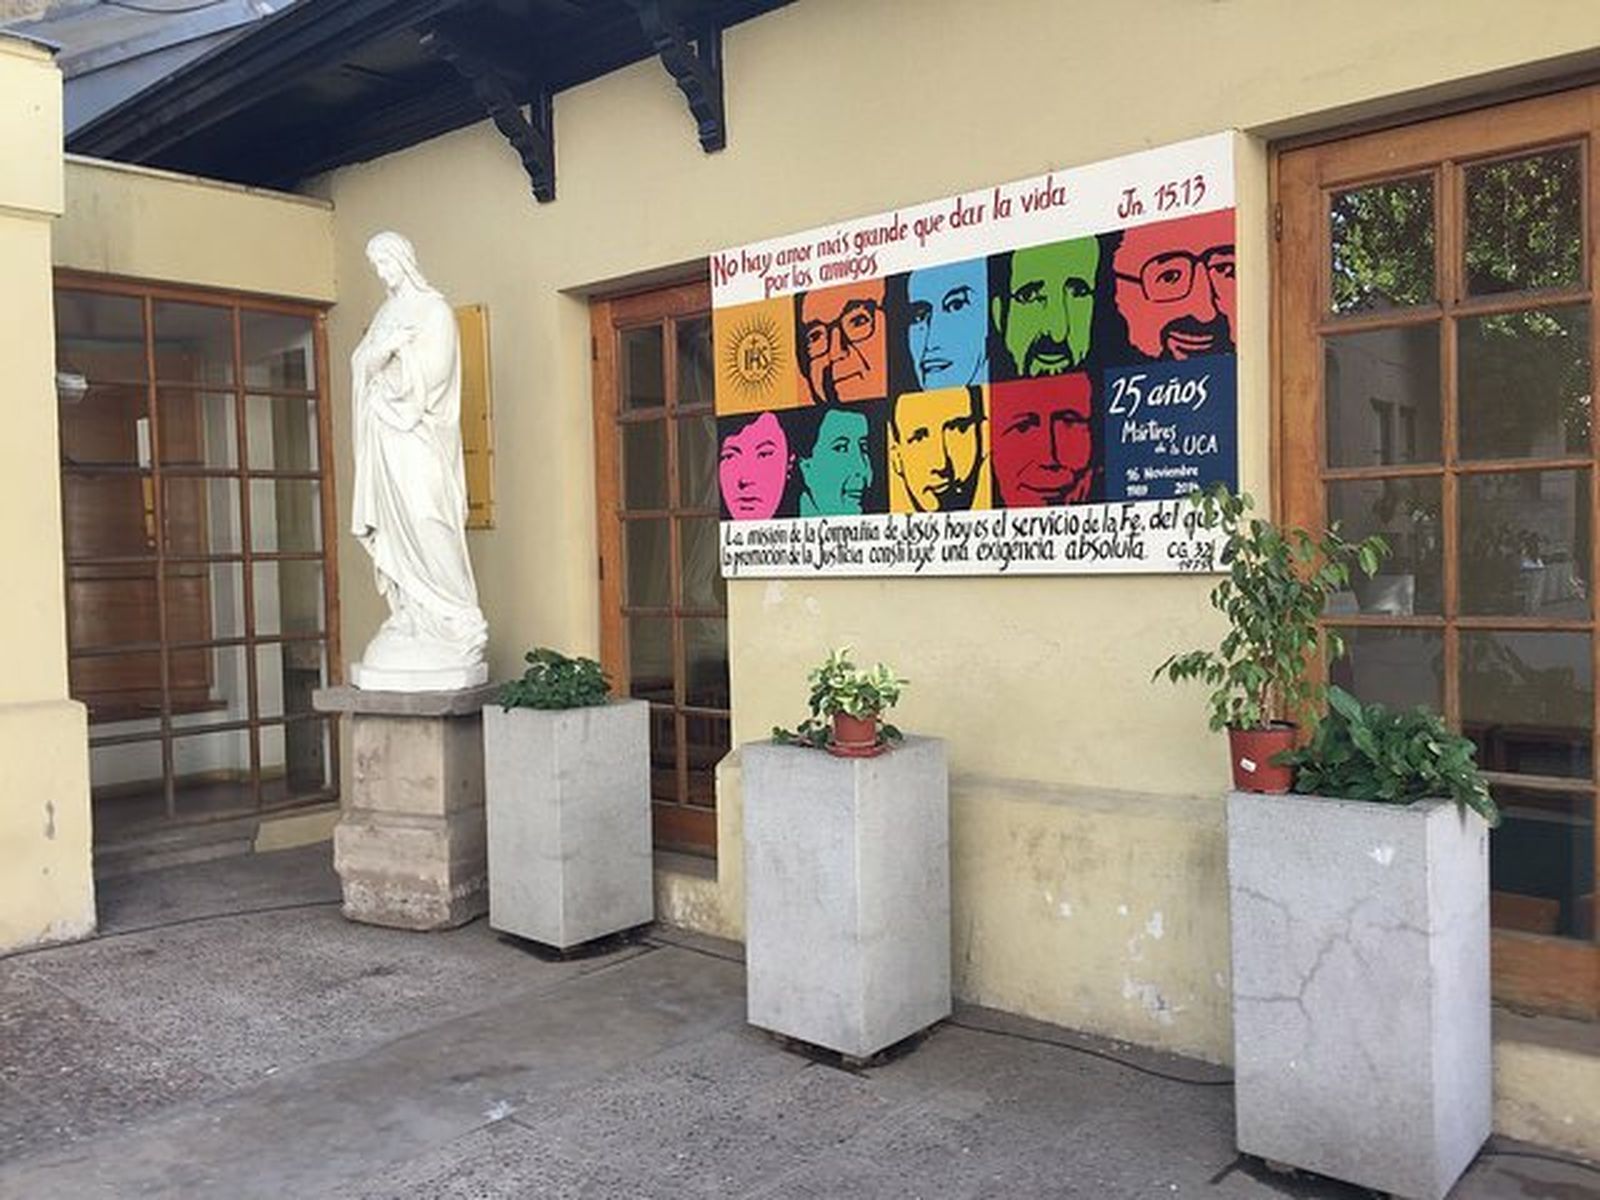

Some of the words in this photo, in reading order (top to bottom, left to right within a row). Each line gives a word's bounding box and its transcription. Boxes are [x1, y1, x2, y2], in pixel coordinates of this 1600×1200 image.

[714, 253, 738, 287] No
[741, 250, 773, 278] hay
[776, 244, 813, 266] amor
[853, 213, 908, 255] grande
[913, 214, 945, 247] que
[949, 197, 985, 228] dar
[993, 187, 1012, 220] la
[1020, 175, 1066, 213] vida
[764, 274, 789, 298] por
[792, 265, 813, 287] los
[819, 254, 878, 282] amigos
[1108, 374, 1147, 418] 25
[1147, 375, 1210, 411] años
[1182, 434, 1219, 456] UCA
[1143, 465, 1199, 480] Noviembre
[725, 524, 744, 546] La
[789, 522, 801, 543] de
[804, 521, 816, 543] la
[884, 515, 899, 541] de
[944, 514, 972, 548] hoy
[974, 519, 989, 541] es
[992, 511, 1006, 538] el
[1011, 510, 1080, 540] servicio
[1082, 508, 1100, 534] de
[1102, 504, 1117, 535] la
[1149, 501, 1180, 530] del
[801, 543, 813, 566] la
[942, 545, 969, 562] una
[976, 537, 1057, 572] exigencia
